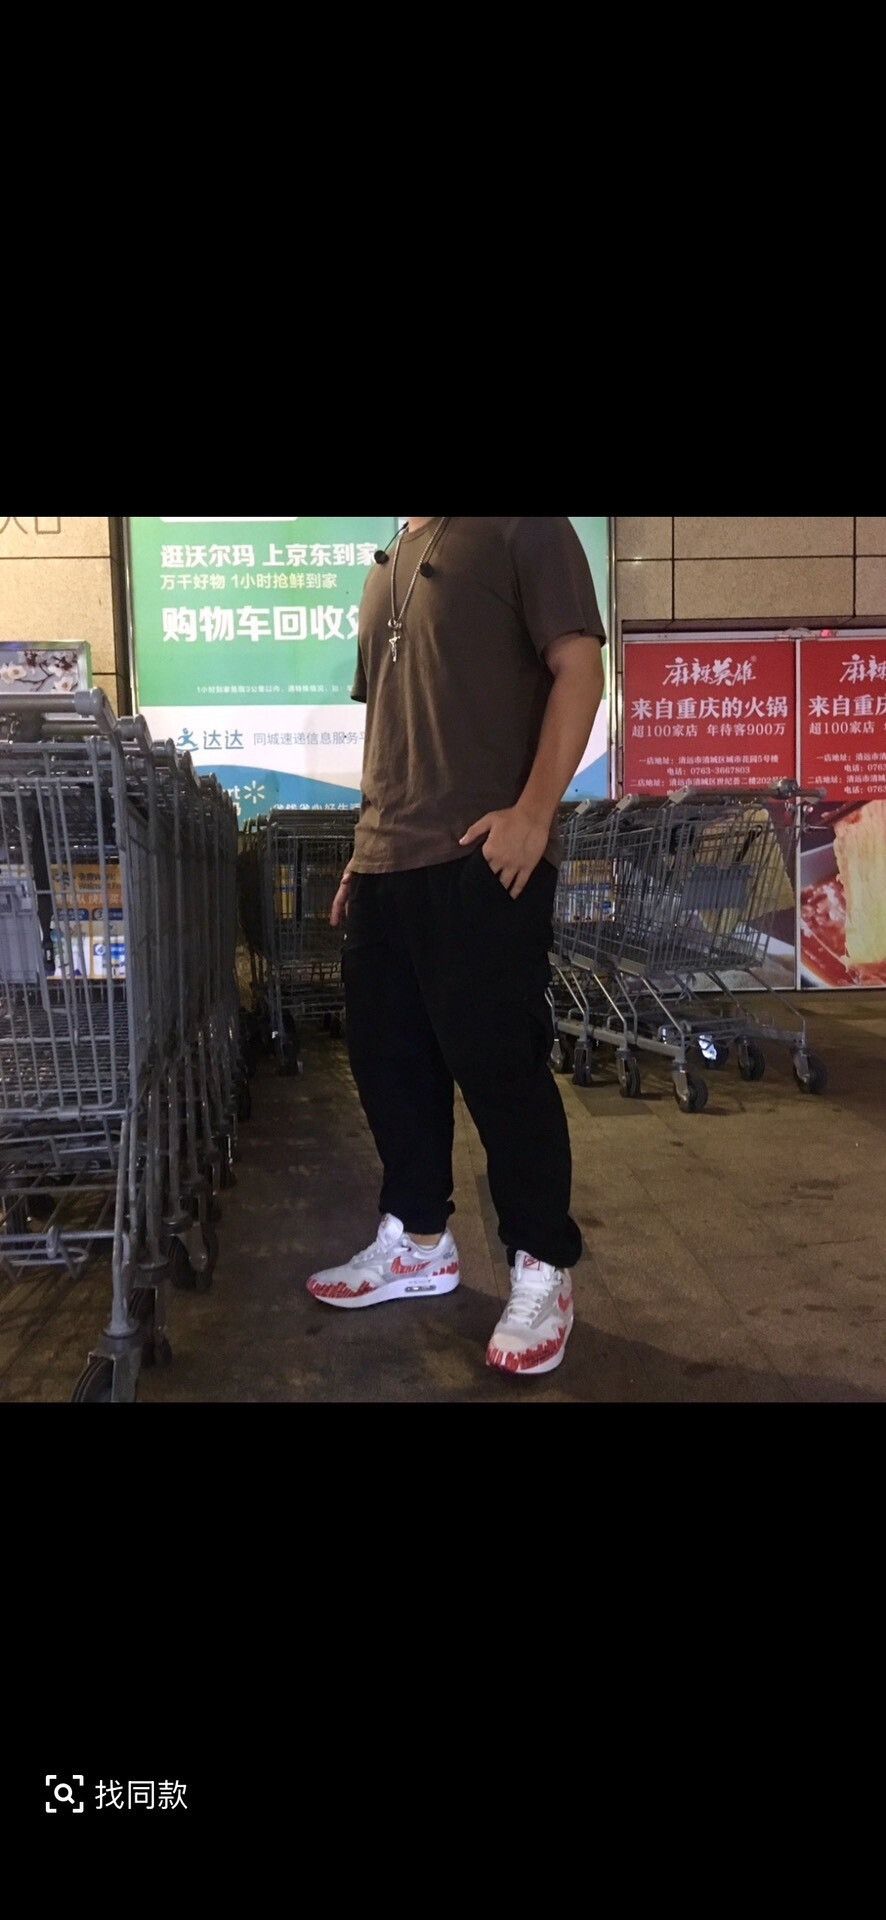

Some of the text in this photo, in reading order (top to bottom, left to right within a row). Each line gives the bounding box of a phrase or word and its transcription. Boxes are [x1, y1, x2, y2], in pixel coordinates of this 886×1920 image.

[160, 543, 378, 569] 逛沃尔玛 上京东到家
[160, 572, 338, 590] 万千好物 1小时抢鲜到家
[662, 656, 757, 687] 麻辣英雄
[631, 696, 788, 720] 来自重庆的火锅
[632, 723, 786, 738] 超100家店 年待客900万
[809, 721, 876, 735] 超100家店
[203, 729, 244, 751] 达达
